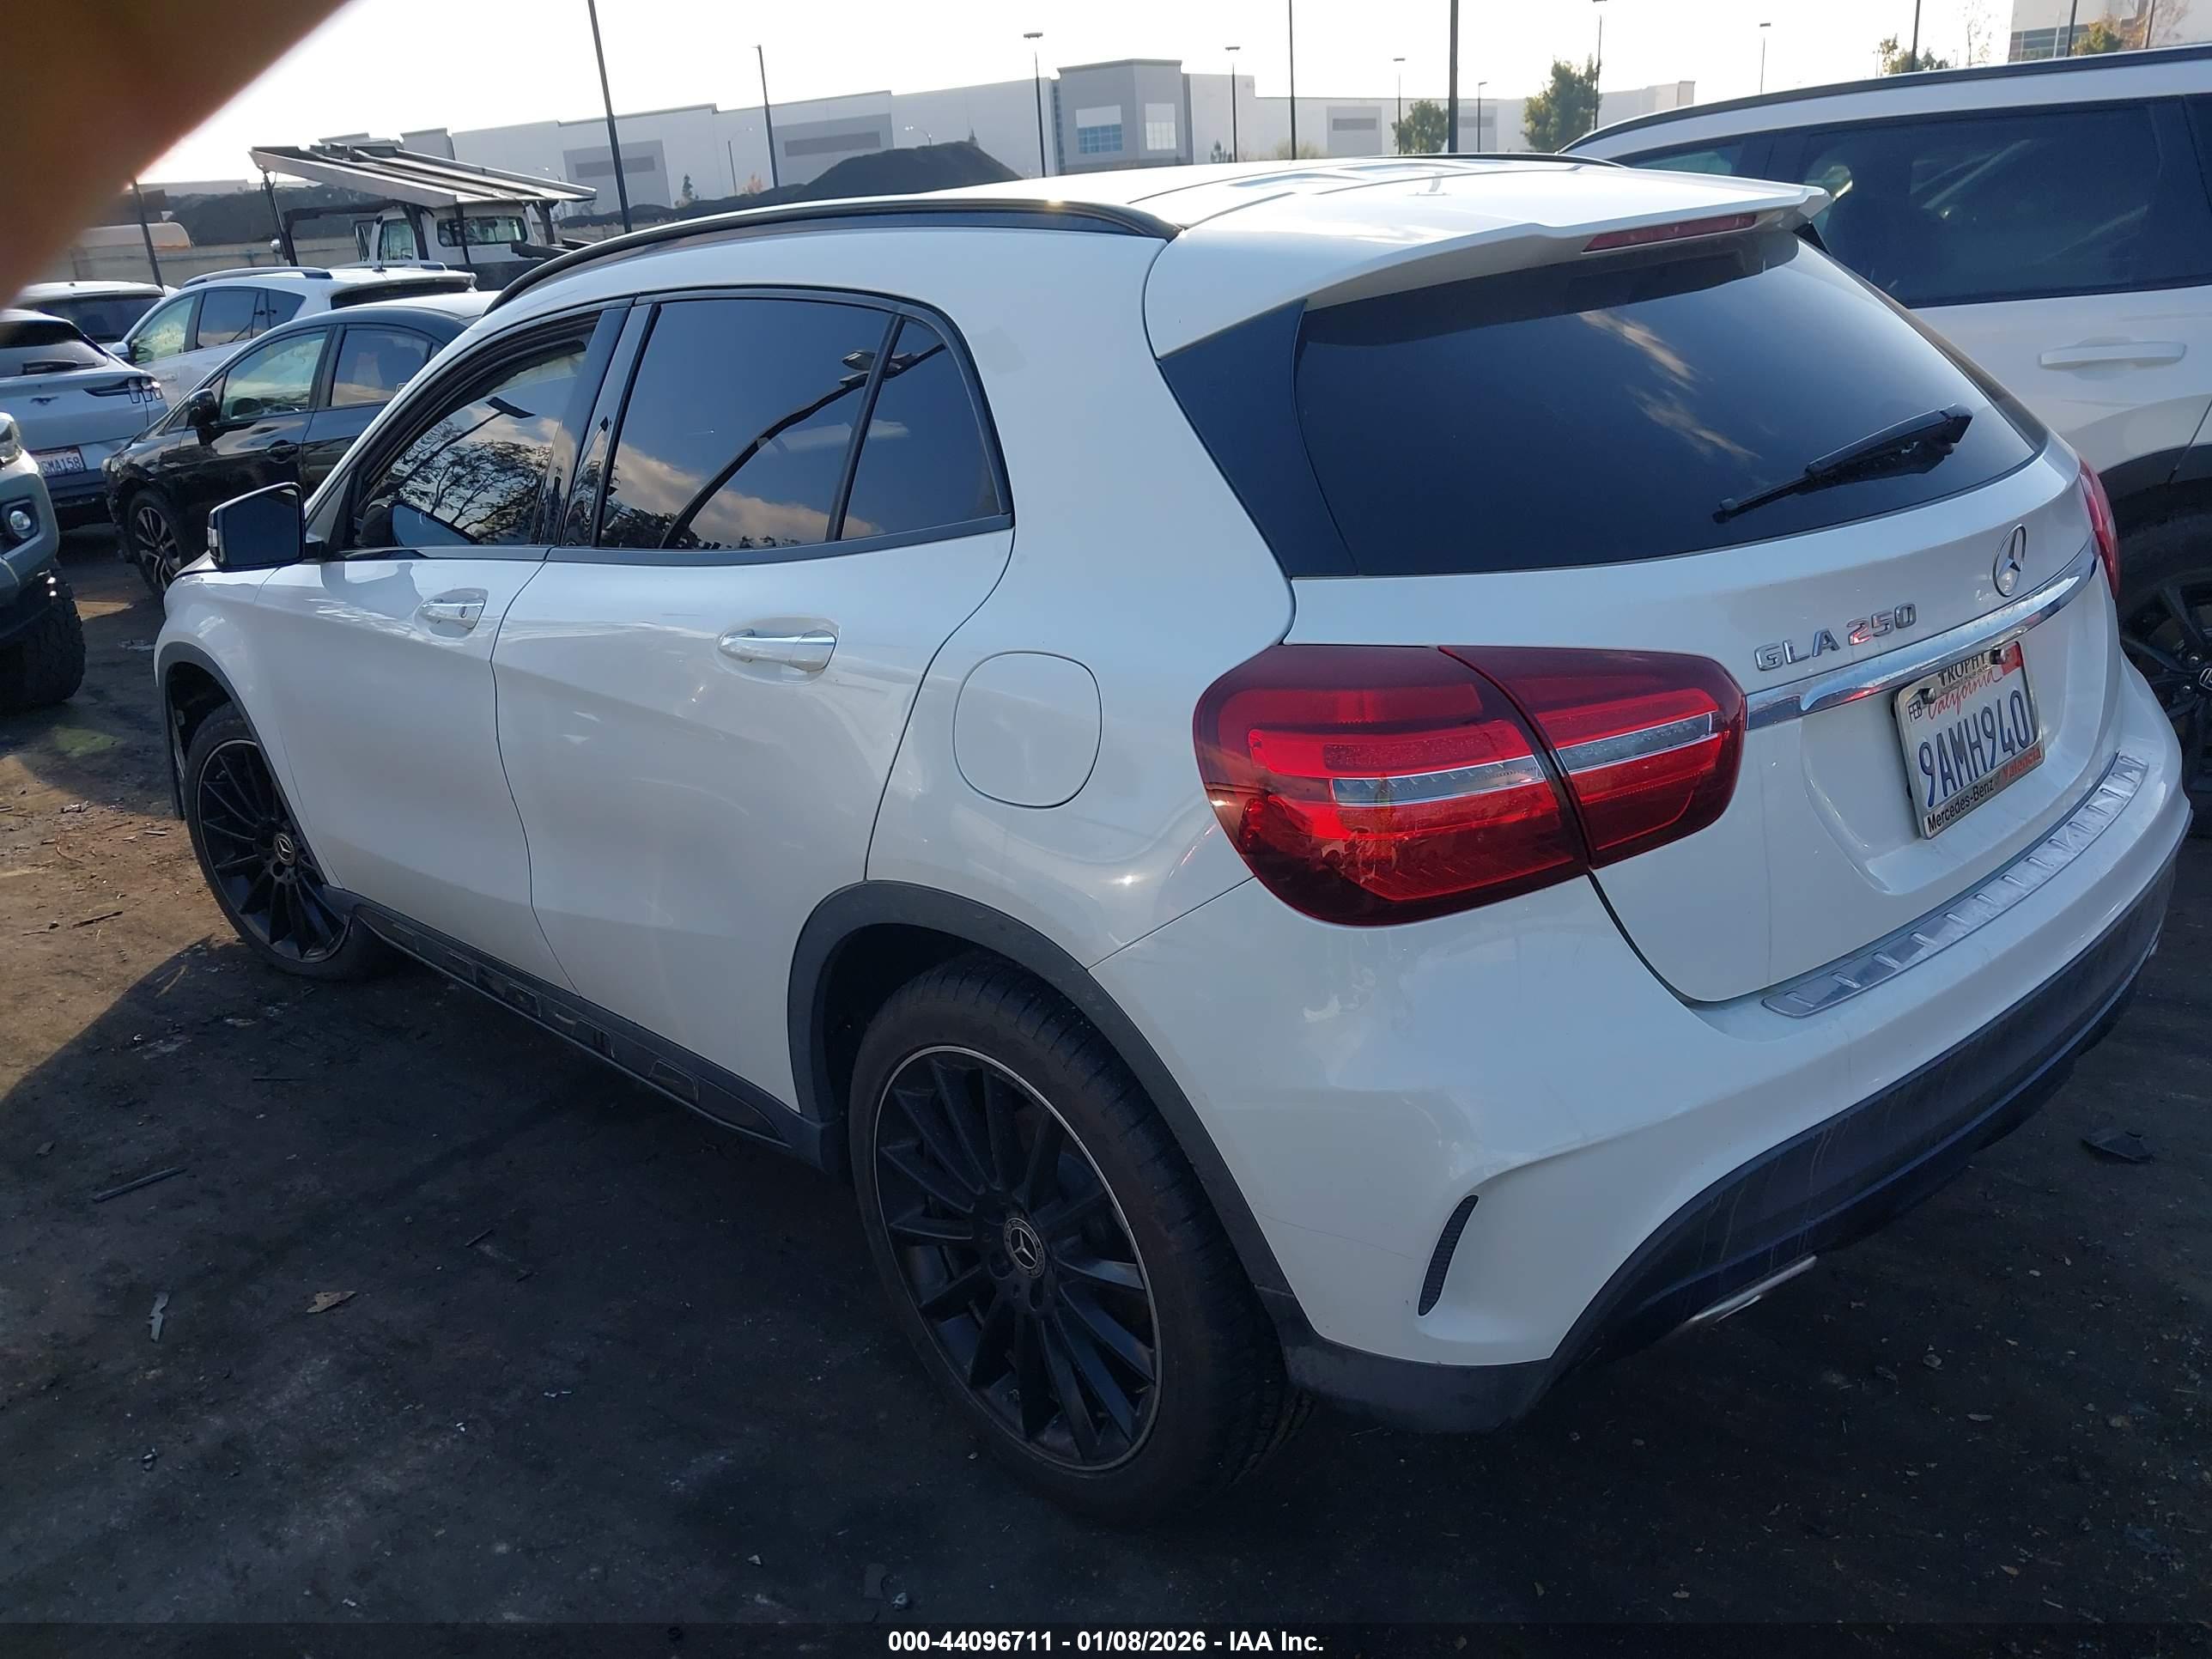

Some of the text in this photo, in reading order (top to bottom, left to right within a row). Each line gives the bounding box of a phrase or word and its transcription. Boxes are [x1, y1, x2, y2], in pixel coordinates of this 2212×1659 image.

[37, 457, 82, 473] GMA158
[1754, 604, 1917, 672] GLA 250
[1908, 700, 1923, 722] FEB
[1928, 669, 2002, 720] California
[1918, 690, 2030, 808] 9AMH940
[1927, 779, 1994, 833] Mercedes-Benz
